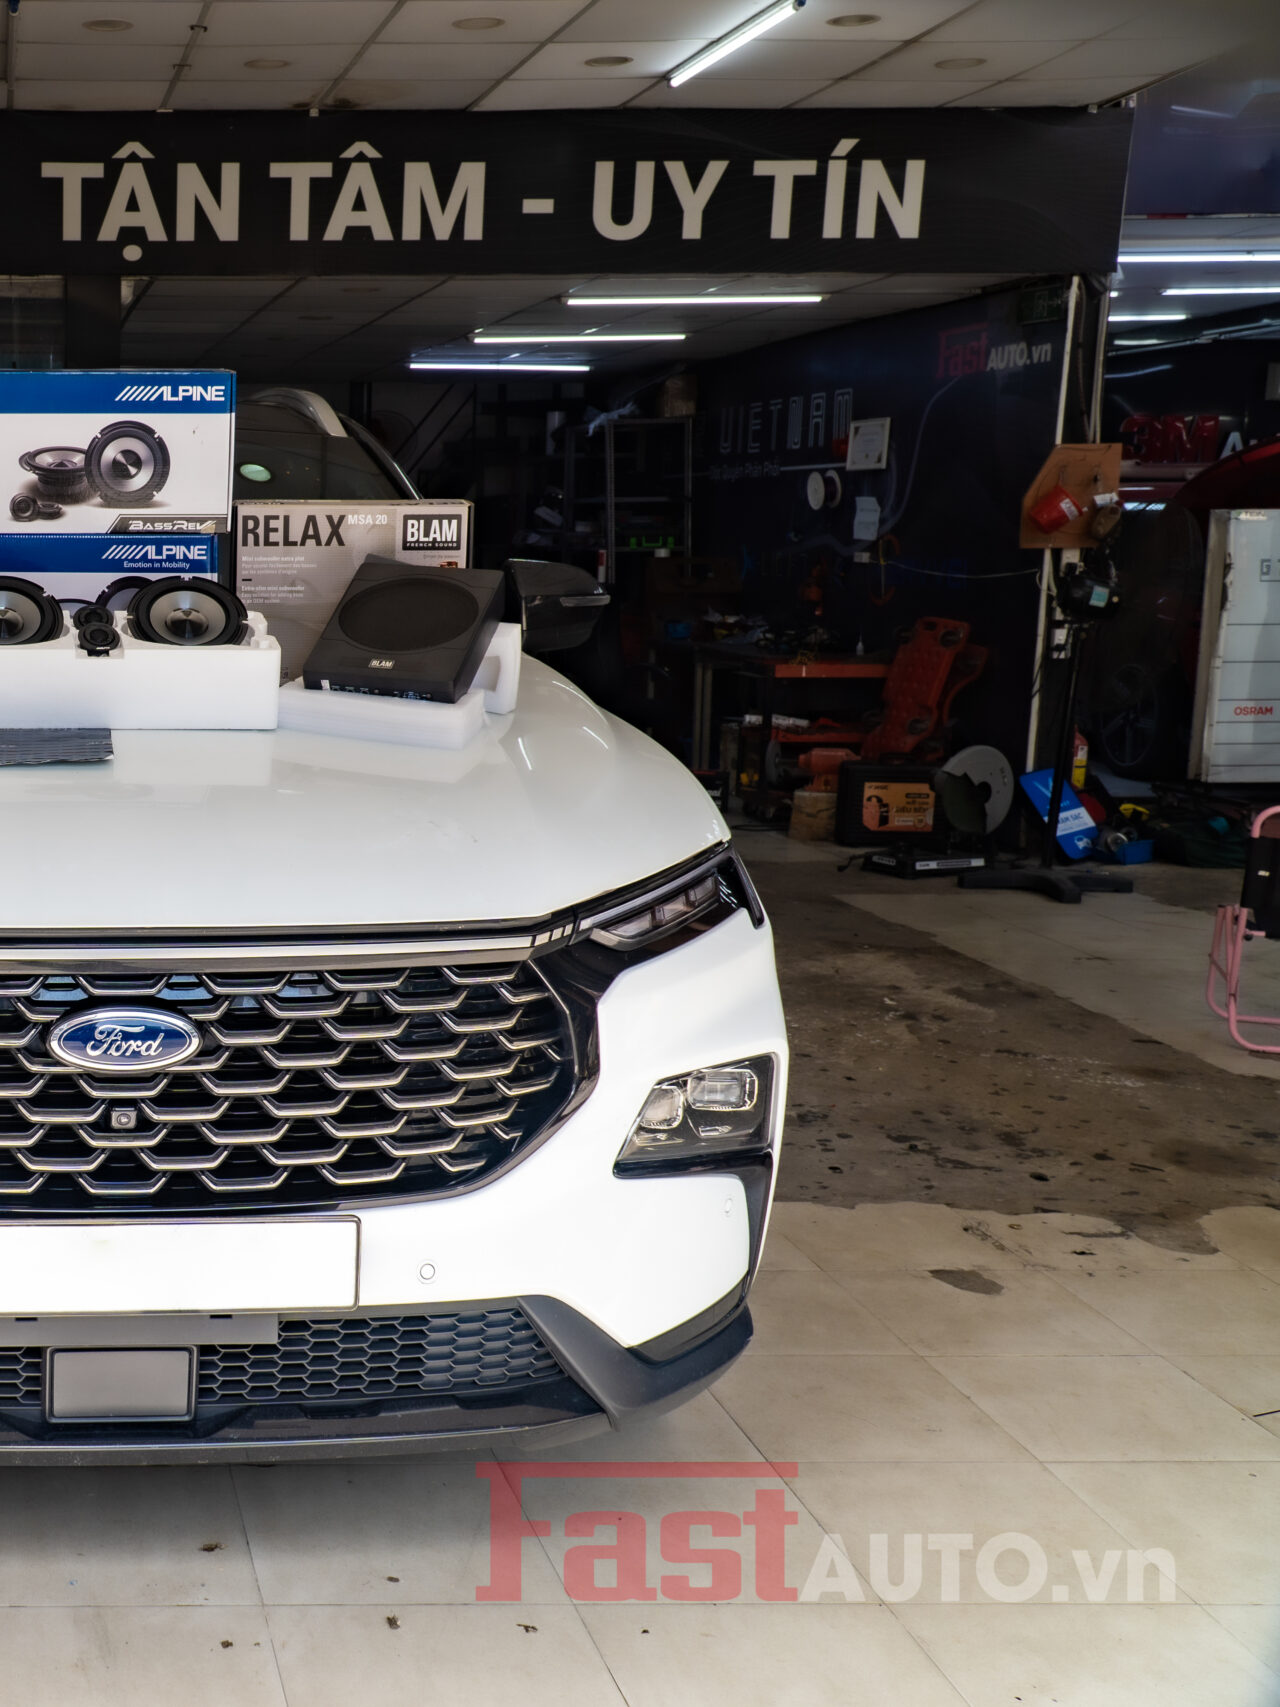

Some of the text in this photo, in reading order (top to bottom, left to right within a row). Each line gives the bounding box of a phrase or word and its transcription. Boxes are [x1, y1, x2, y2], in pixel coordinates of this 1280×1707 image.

[41, 141, 240, 262] TẬN
[270, 141, 486, 242] TÂM
[592, 160, 730, 242] UY
[753, 138, 926, 241] TÍN
[986, 341, 1052, 372] AUTO.vn
[115, 385, 226, 401] ALPINE
[241, 514, 388, 547] RELAX MSA 20
[406, 519, 458, 542] BLAM
[101, 544, 208, 560] ALPINE
[123, 560, 191, 570] Emotion in Mobility
[371, 660, 393, 668] BLAM
[1233, 705, 1274, 716] OSRAM
[86, 1024, 165, 1057] Ford
